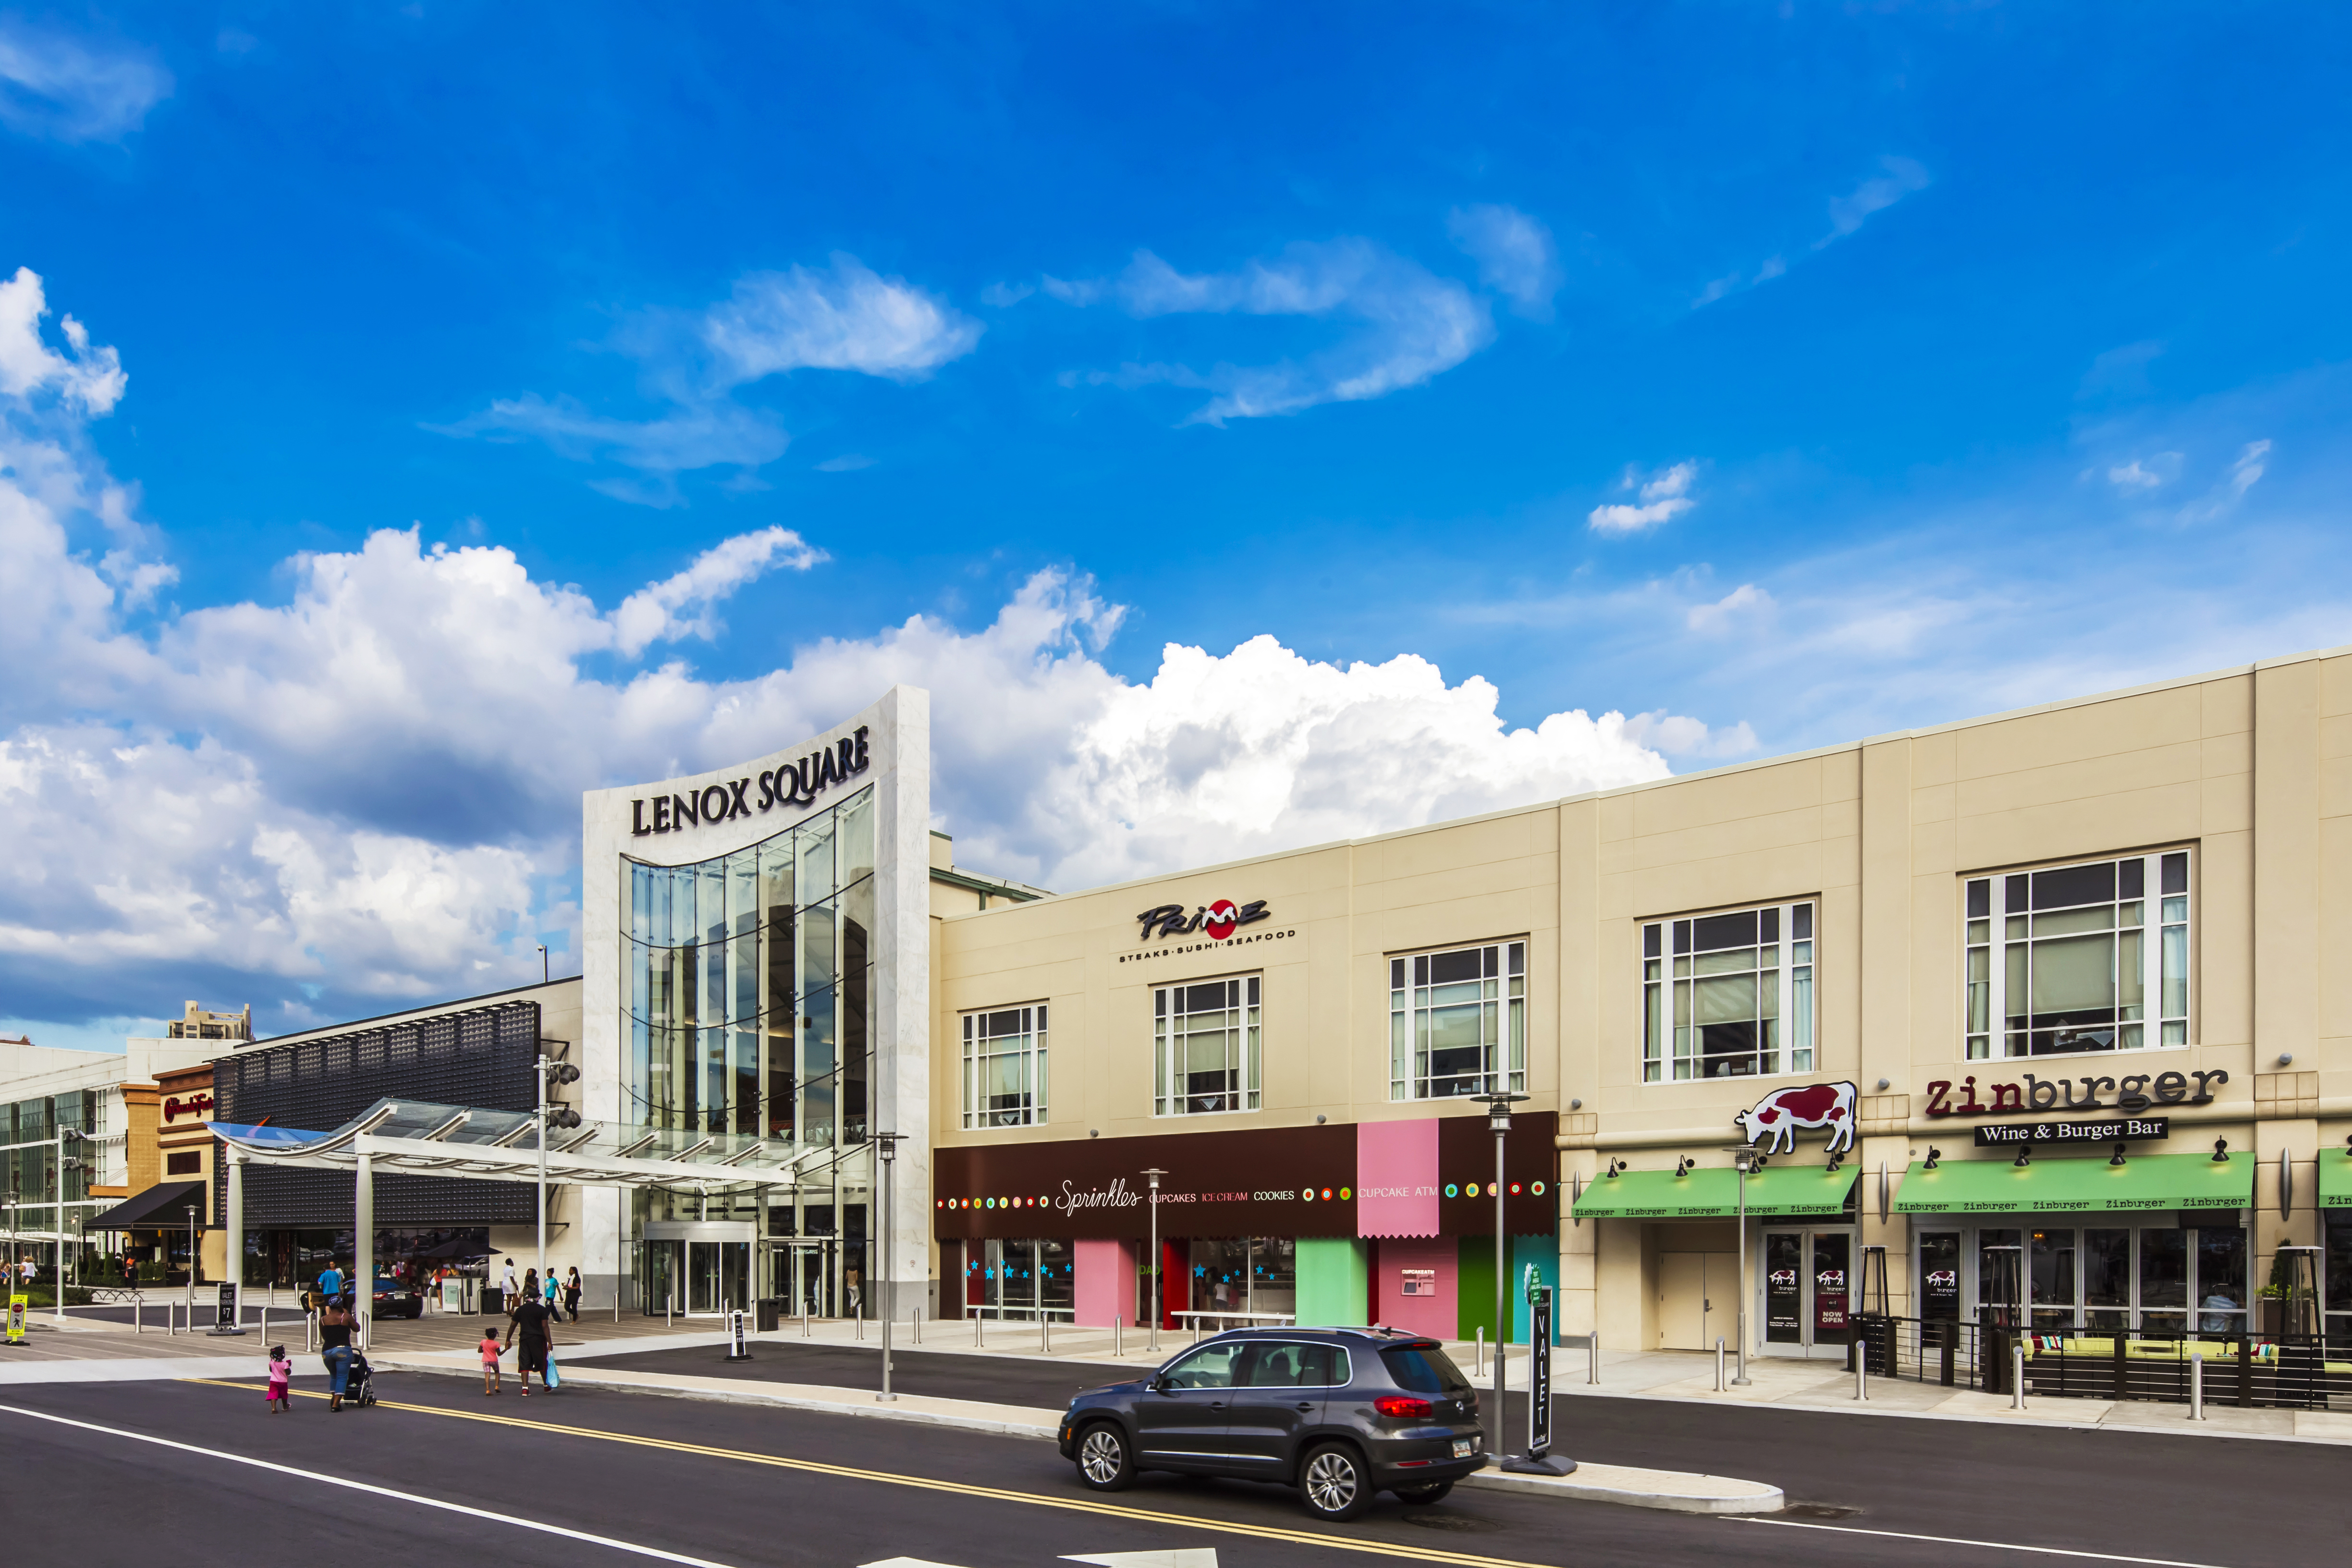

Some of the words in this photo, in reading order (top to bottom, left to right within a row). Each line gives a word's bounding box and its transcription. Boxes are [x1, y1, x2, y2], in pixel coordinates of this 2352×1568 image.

[631, 777, 752, 834] LENOX
[758, 725, 869, 810] SQUARE
[1925, 1069, 2229, 1115] Zinburger
[1983, 1125, 2029, 1141] Wine
[2034, 1125, 2051, 1139] &
[2057, 1122, 2121, 1140] Burger
[2127, 1120, 2162, 1135] Bar
[1055, 1178, 1143, 1217] Sprinkles
[1202, 1193, 1216, 1202] ICE
[1217, 1192, 1248, 1201] CREAM
[1254, 1190, 1295, 1201] COOKIES
[1359, 1187, 1409, 1198] CUPCAKE
[1415, 1186, 1438, 1196] ATM
[1790, 1205, 1838, 1213] Zinburger
[1898, 1203, 1949, 1212] Zinburger
[1964, 1202, 2017, 1211] Zinburger
[2033, 1201, 2090, 1210] Zinburger
[2106, 1199, 2165, 1208] Zinburger
[2183, 1198, 2246, 1207] Zinburger
[222, 1308, 231, 1318] $7
[1538, 1315, 1546, 1425] VALET
